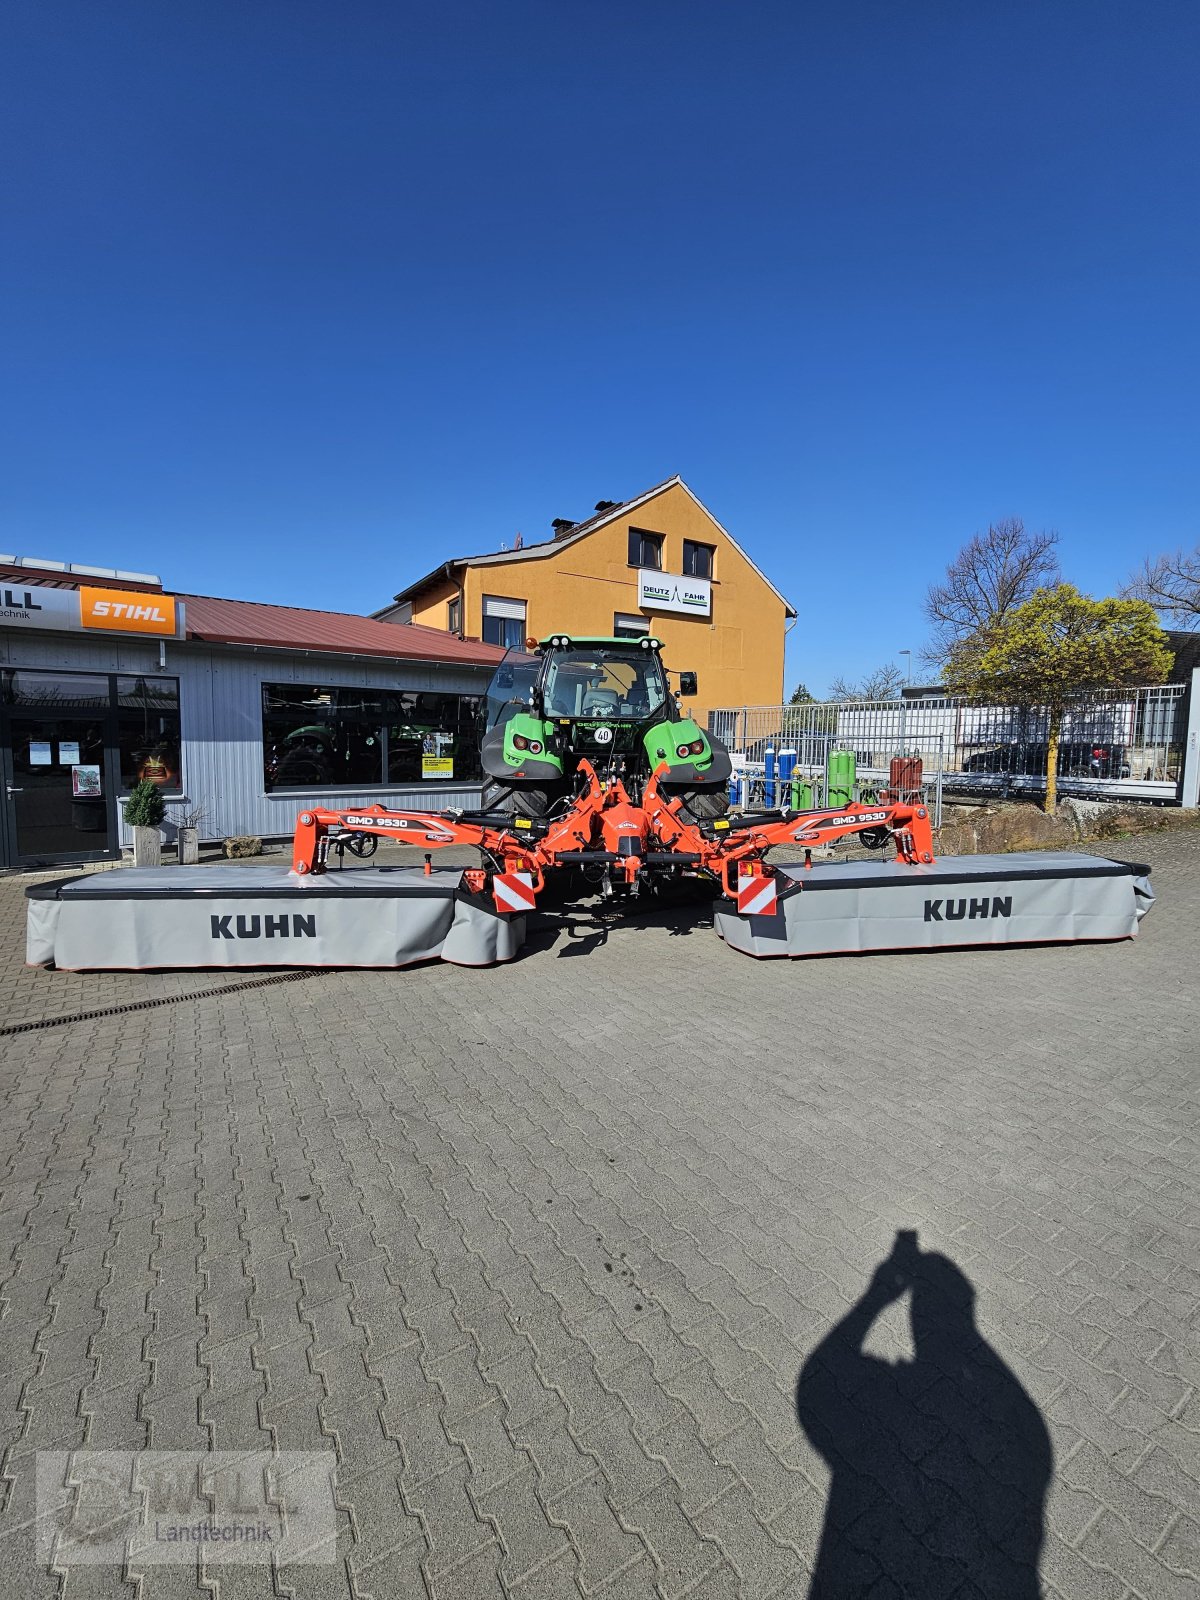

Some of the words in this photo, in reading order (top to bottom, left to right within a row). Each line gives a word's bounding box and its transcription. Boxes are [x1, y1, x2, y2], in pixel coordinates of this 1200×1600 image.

[0, 589, 42, 611] LL
[643, 585, 670, 596] DEUTZ
[684, 592, 705, 601] FAHR
[91, 601, 167, 622] STIHL
[597, 730, 609, 741] 40
[347, 815, 374, 825] GMD
[377, 818, 408, 828] 9530
[833, 815, 857, 825] GMD
[858, 812, 886, 822] 9530
[924, 896, 1013, 922] KUHN
[210, 914, 317, 940] KUHN
